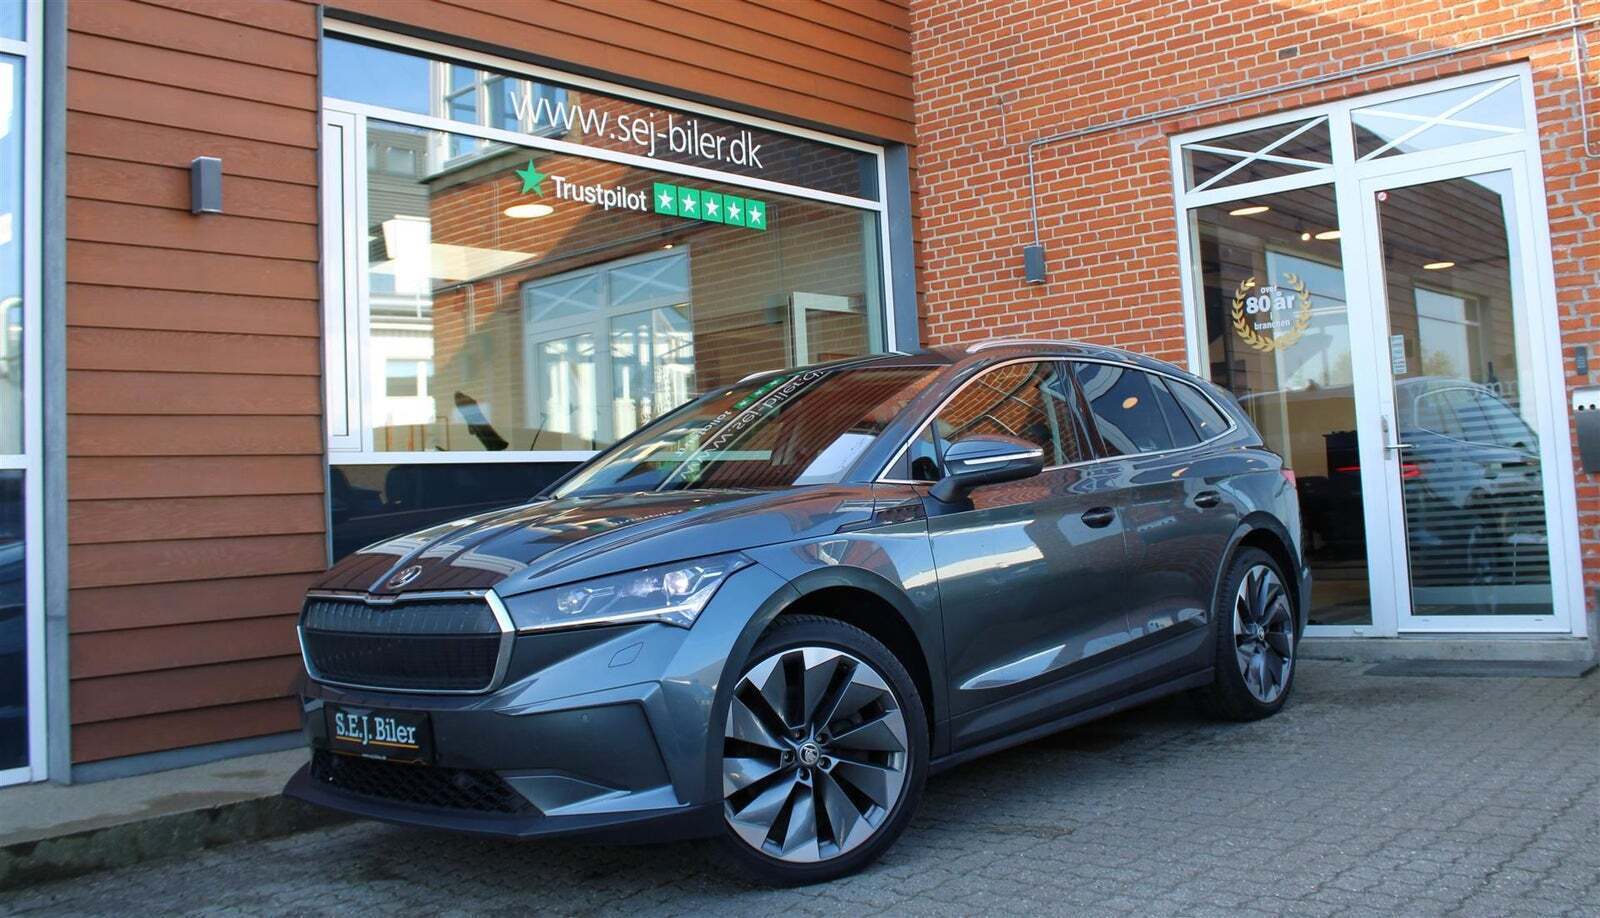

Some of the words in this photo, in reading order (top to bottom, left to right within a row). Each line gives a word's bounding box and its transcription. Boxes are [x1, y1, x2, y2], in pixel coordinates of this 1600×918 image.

[510, 91, 763, 169] www.sej-biler.dk
[551, 175, 647, 212] Trustpilot
[1246, 295, 1271, 314] 80
[1273, 291, 1295, 310] år
[1260, 285, 1277, 294] over
[1254, 319, 1290, 331] branchen
[335, 712, 372, 745] S.E.J.
[374, 716, 416, 744] Biler
